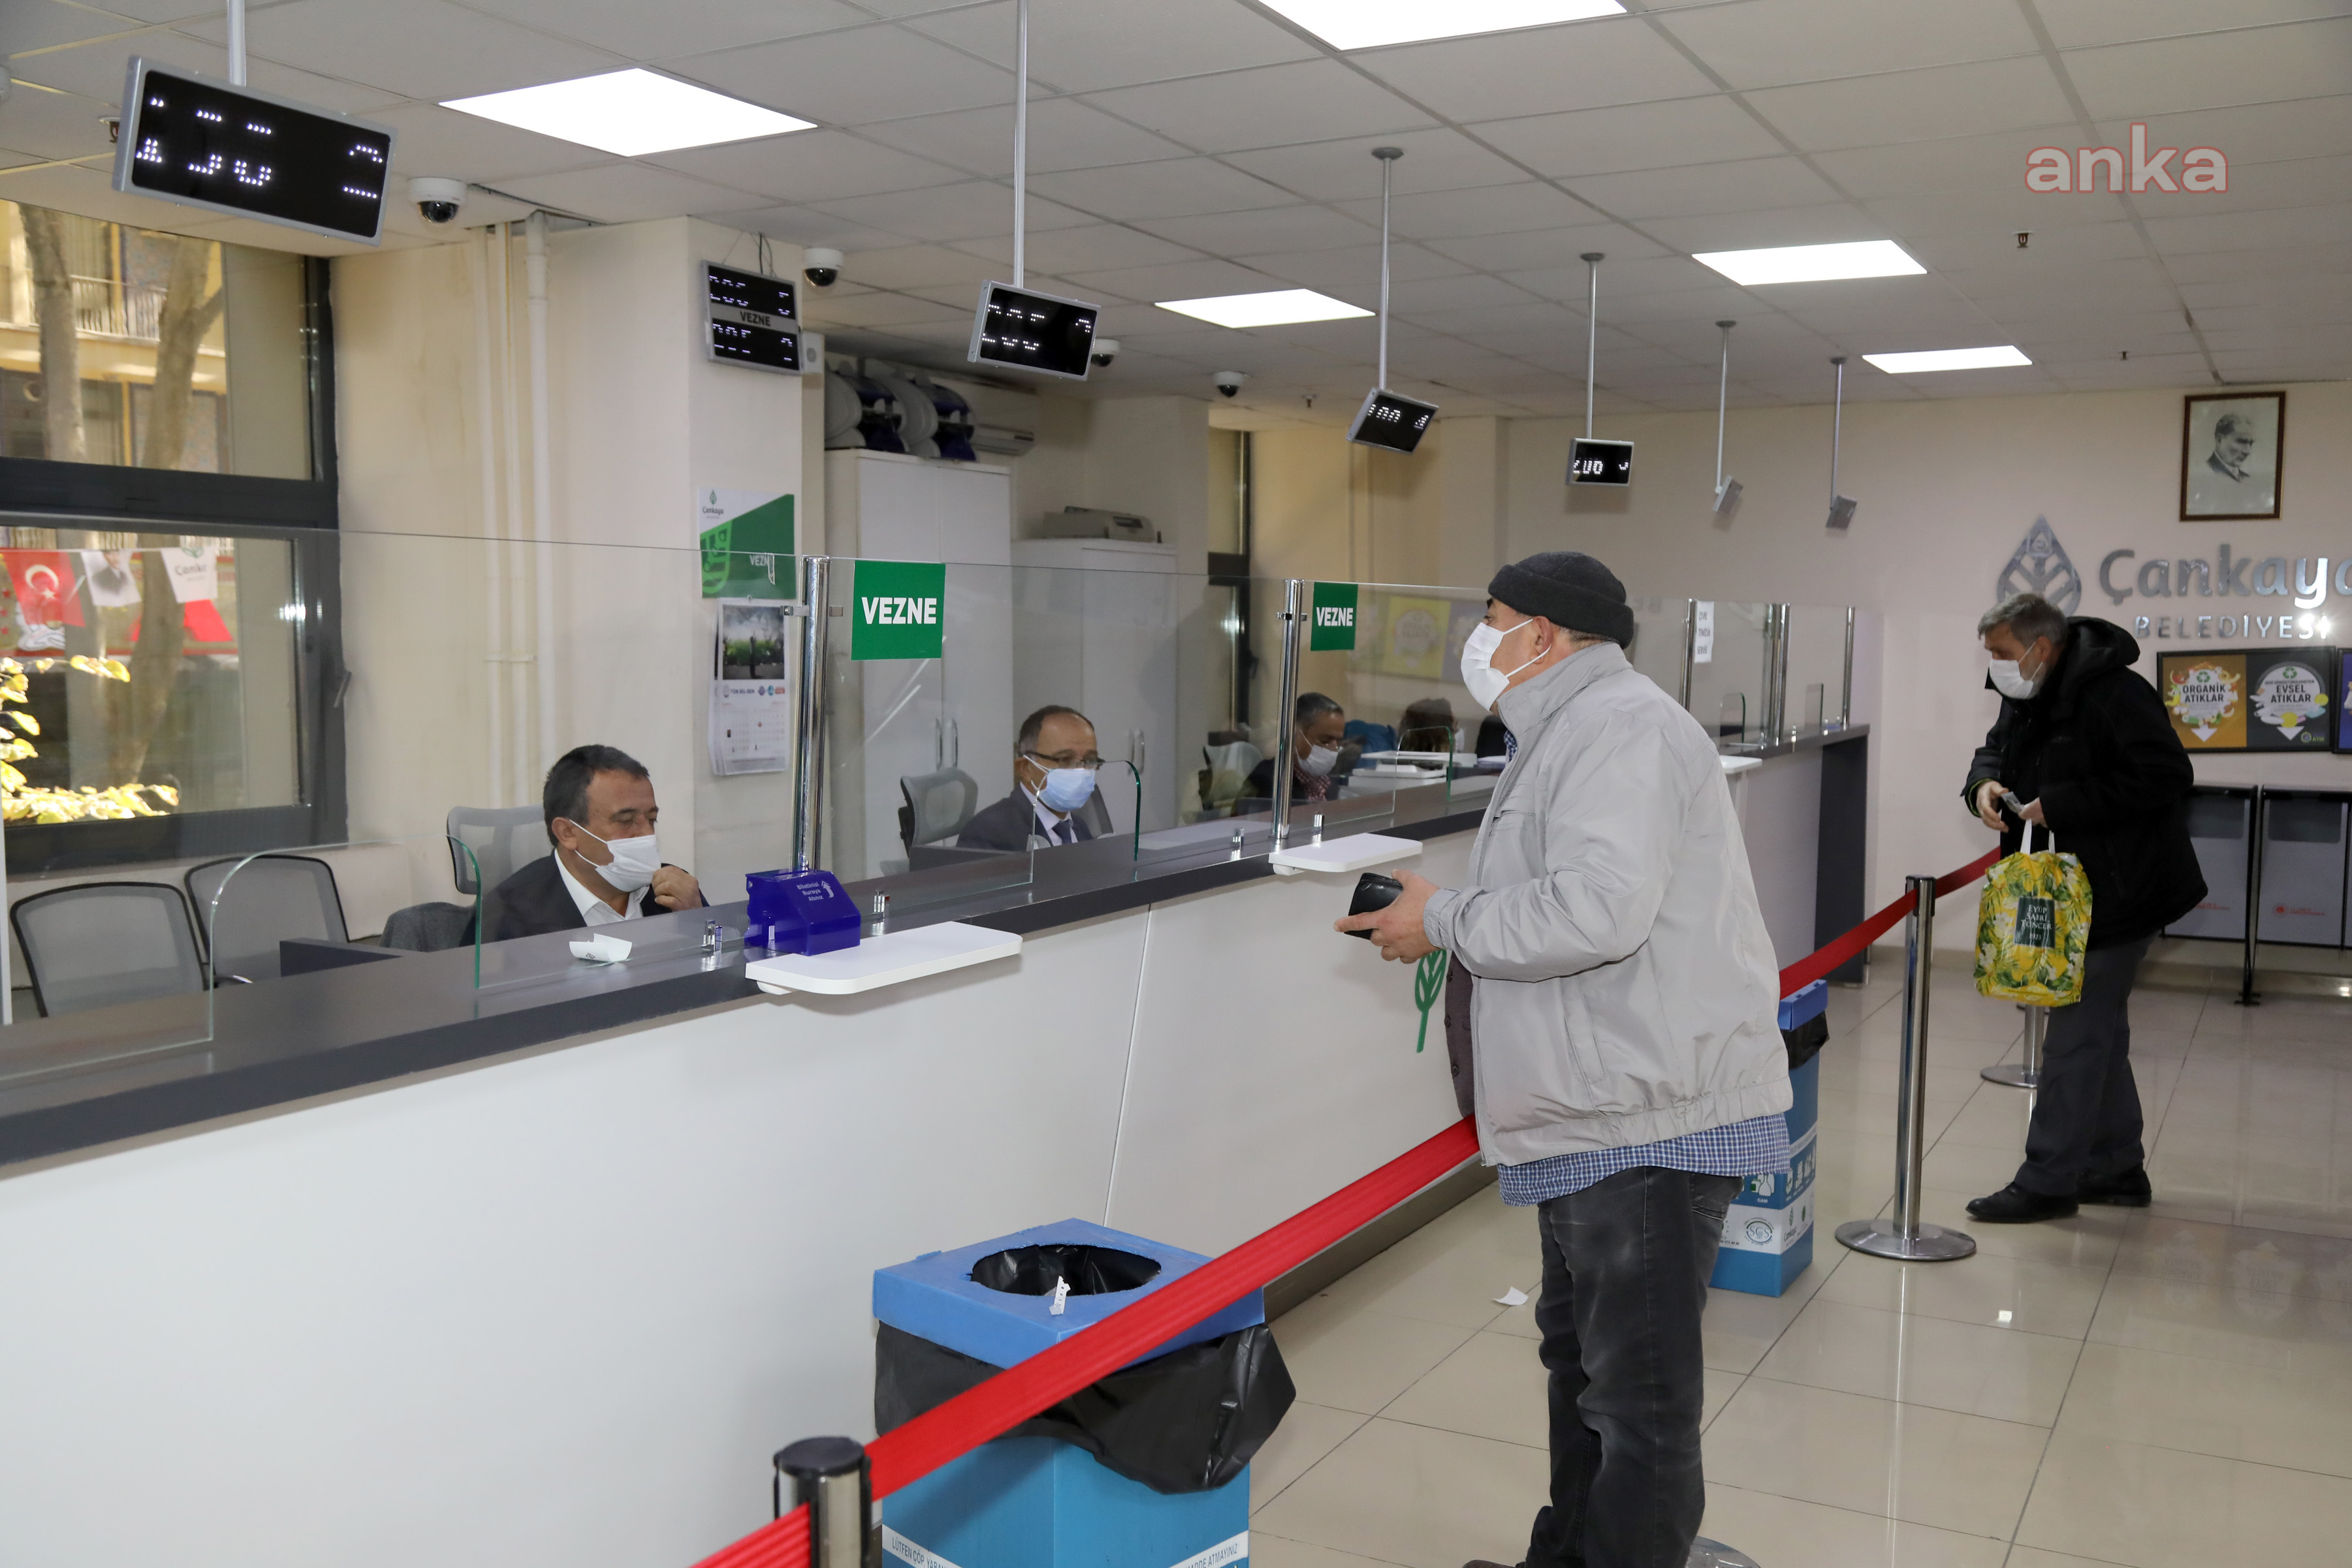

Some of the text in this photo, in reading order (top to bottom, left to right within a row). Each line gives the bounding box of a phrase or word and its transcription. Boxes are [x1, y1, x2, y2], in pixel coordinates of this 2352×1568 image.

[740, 310, 771, 326] VEZNE
[750, 554, 772, 567] VEZN
[862, 597, 937, 625] VEZNE
[1316, 606, 1354, 627] VEZNE
[2135, 612, 2328, 639] BELEDİYESİ
[2182, 681, 2227, 694] ORGANİK
[2276, 684, 2306, 693] EVSEL
[2184, 693, 2224, 703] ATIKLAR
[2270, 694, 2312, 704] ATIKLAR
[796, 881, 820, 890] Biletinizi
[2021, 919, 2052, 930] TUNCER
[892, 1537, 912, 1560] LÜTFEN
[1208, 1543, 1238, 1567] ATMAYINIZ
